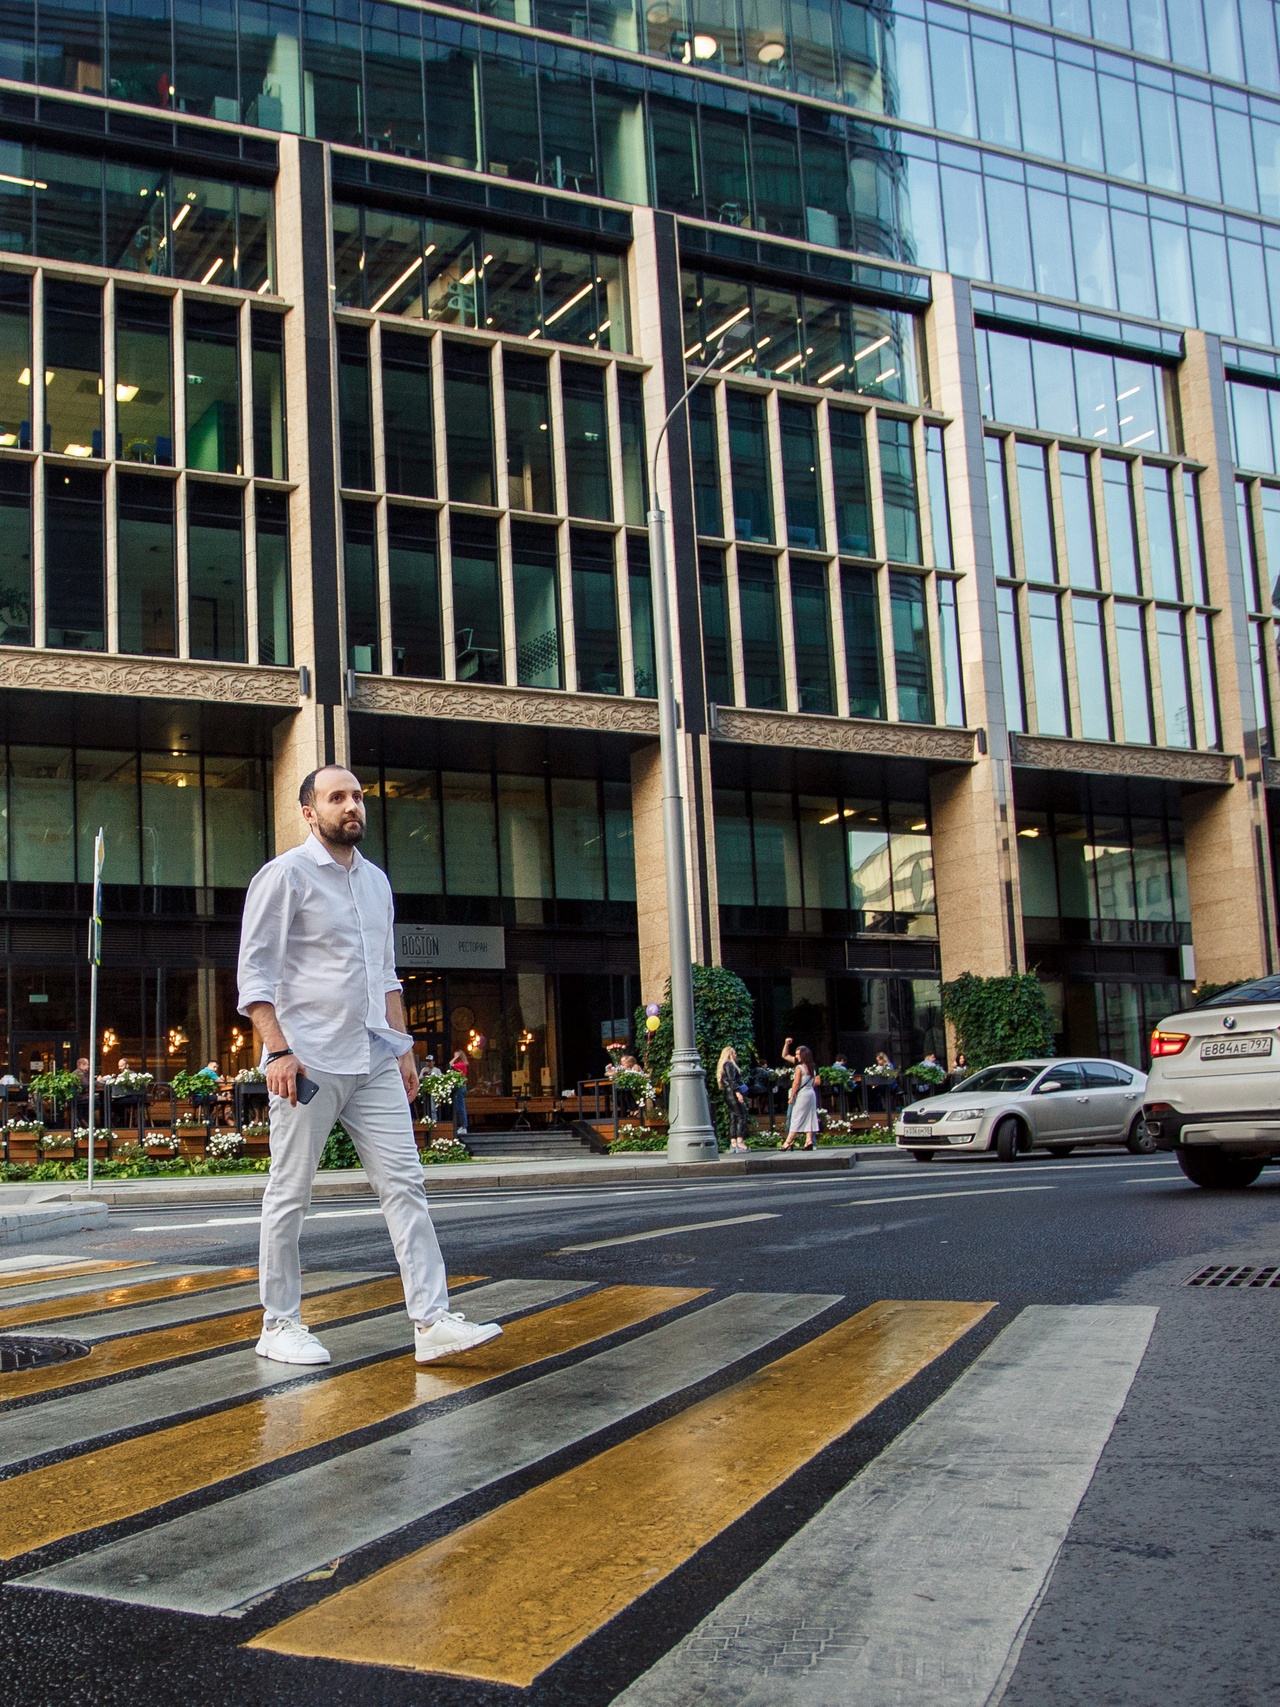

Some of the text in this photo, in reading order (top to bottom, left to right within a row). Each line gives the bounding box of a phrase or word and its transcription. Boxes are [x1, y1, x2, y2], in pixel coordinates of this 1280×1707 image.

[401, 935, 439, 956] BOSTON
[458, 941, 488, 953] РЕСТОРАН
[1250, 1039, 1268, 1049] 797
